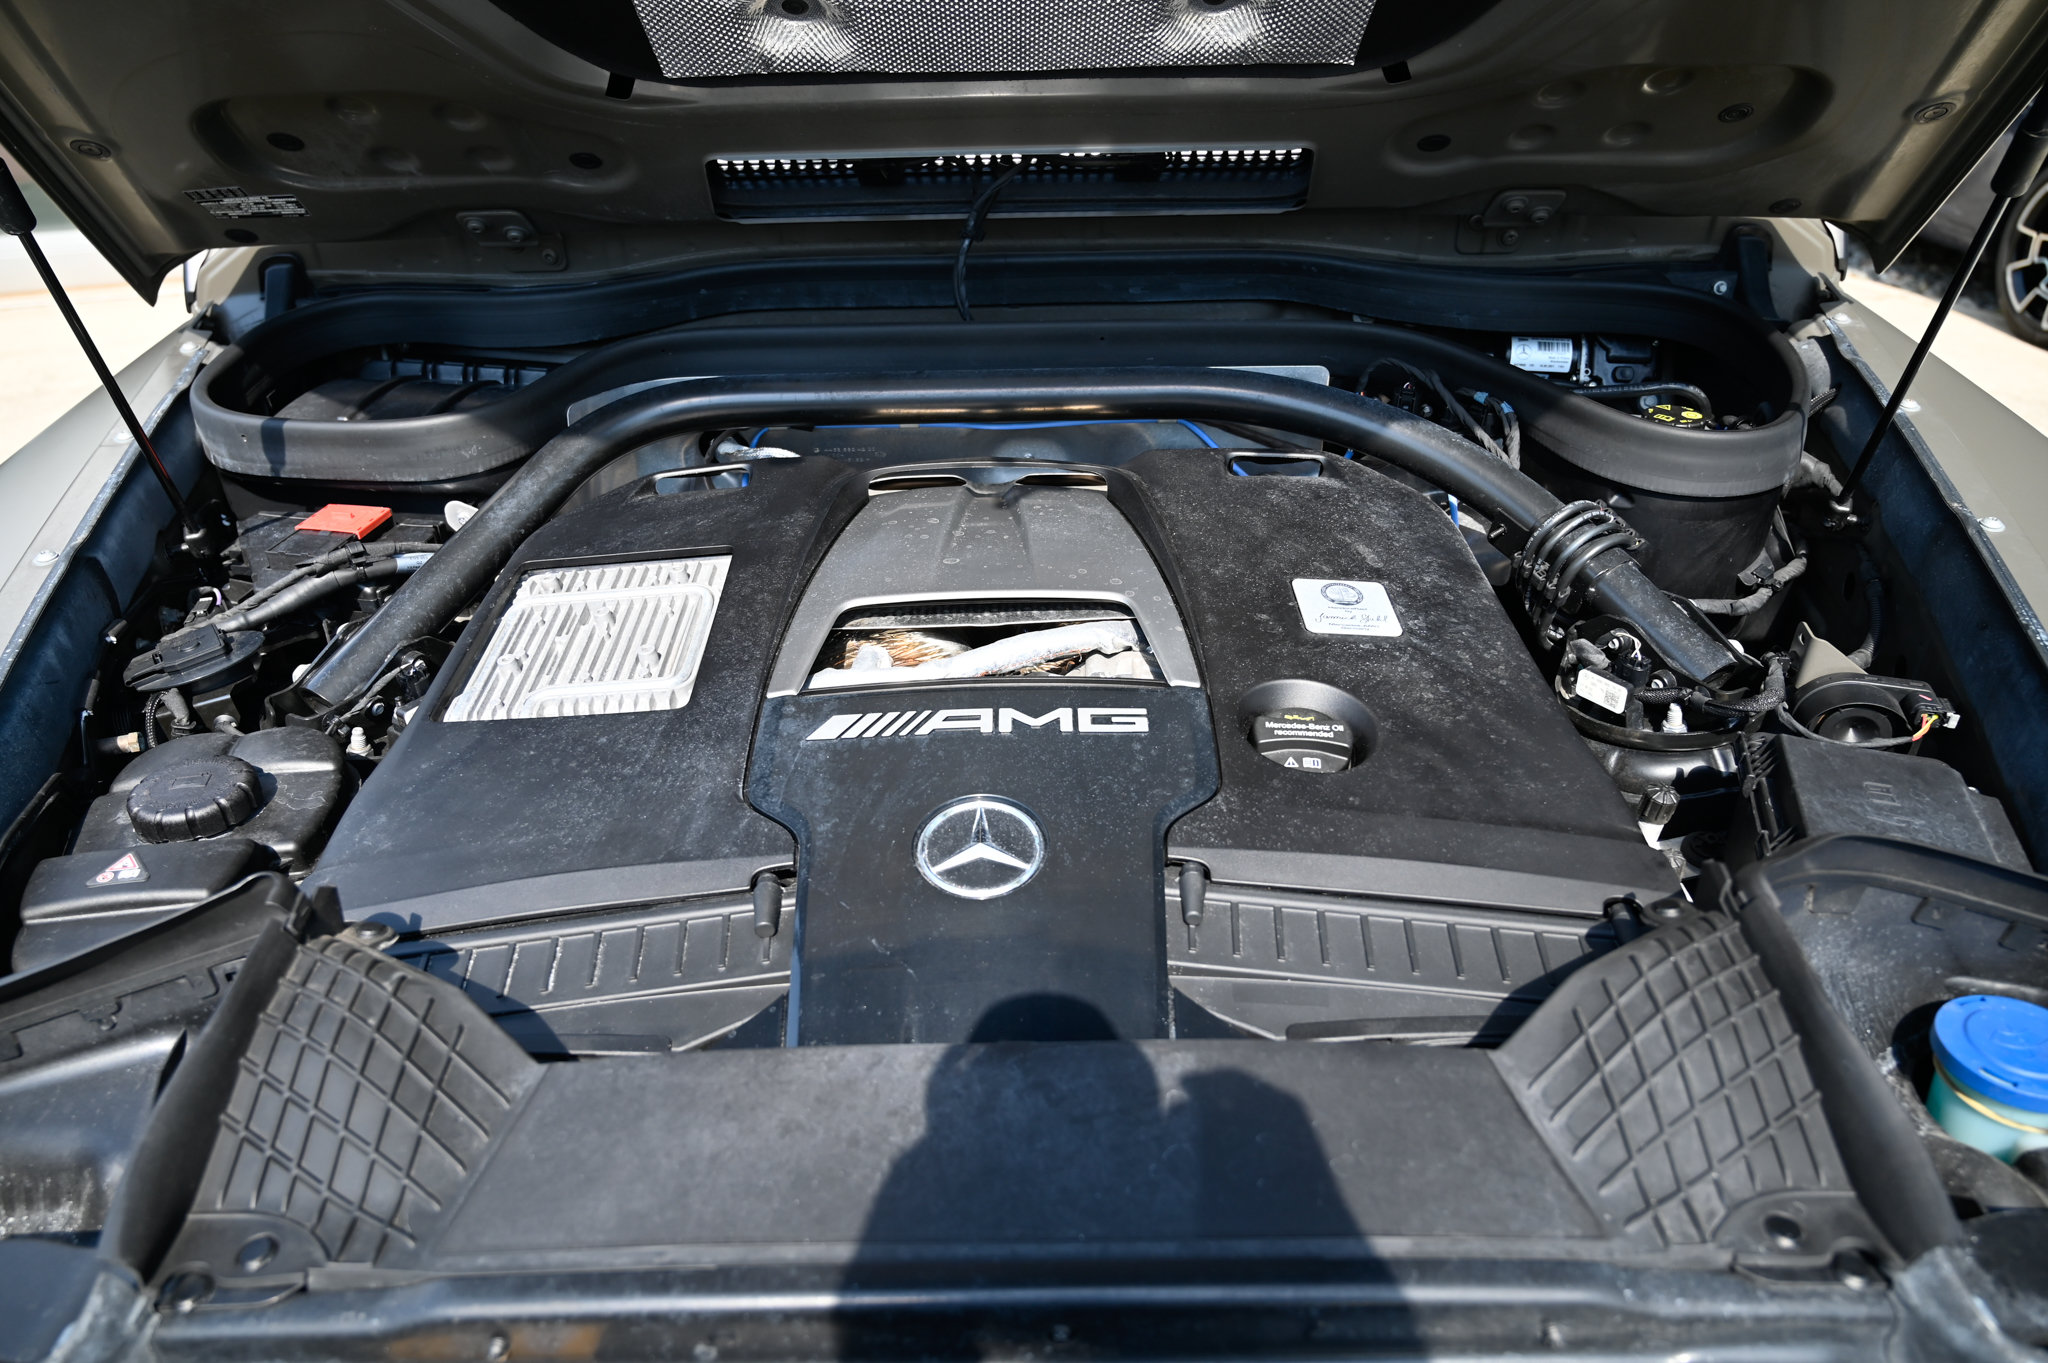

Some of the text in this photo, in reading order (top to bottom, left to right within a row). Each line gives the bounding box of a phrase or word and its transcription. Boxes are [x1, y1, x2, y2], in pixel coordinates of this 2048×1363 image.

[914, 707, 1150, 736] AMG
[1265, 721, 1344, 732] Mercedes-Benz Oil
[1274, 729, 1334, 738] recommended
